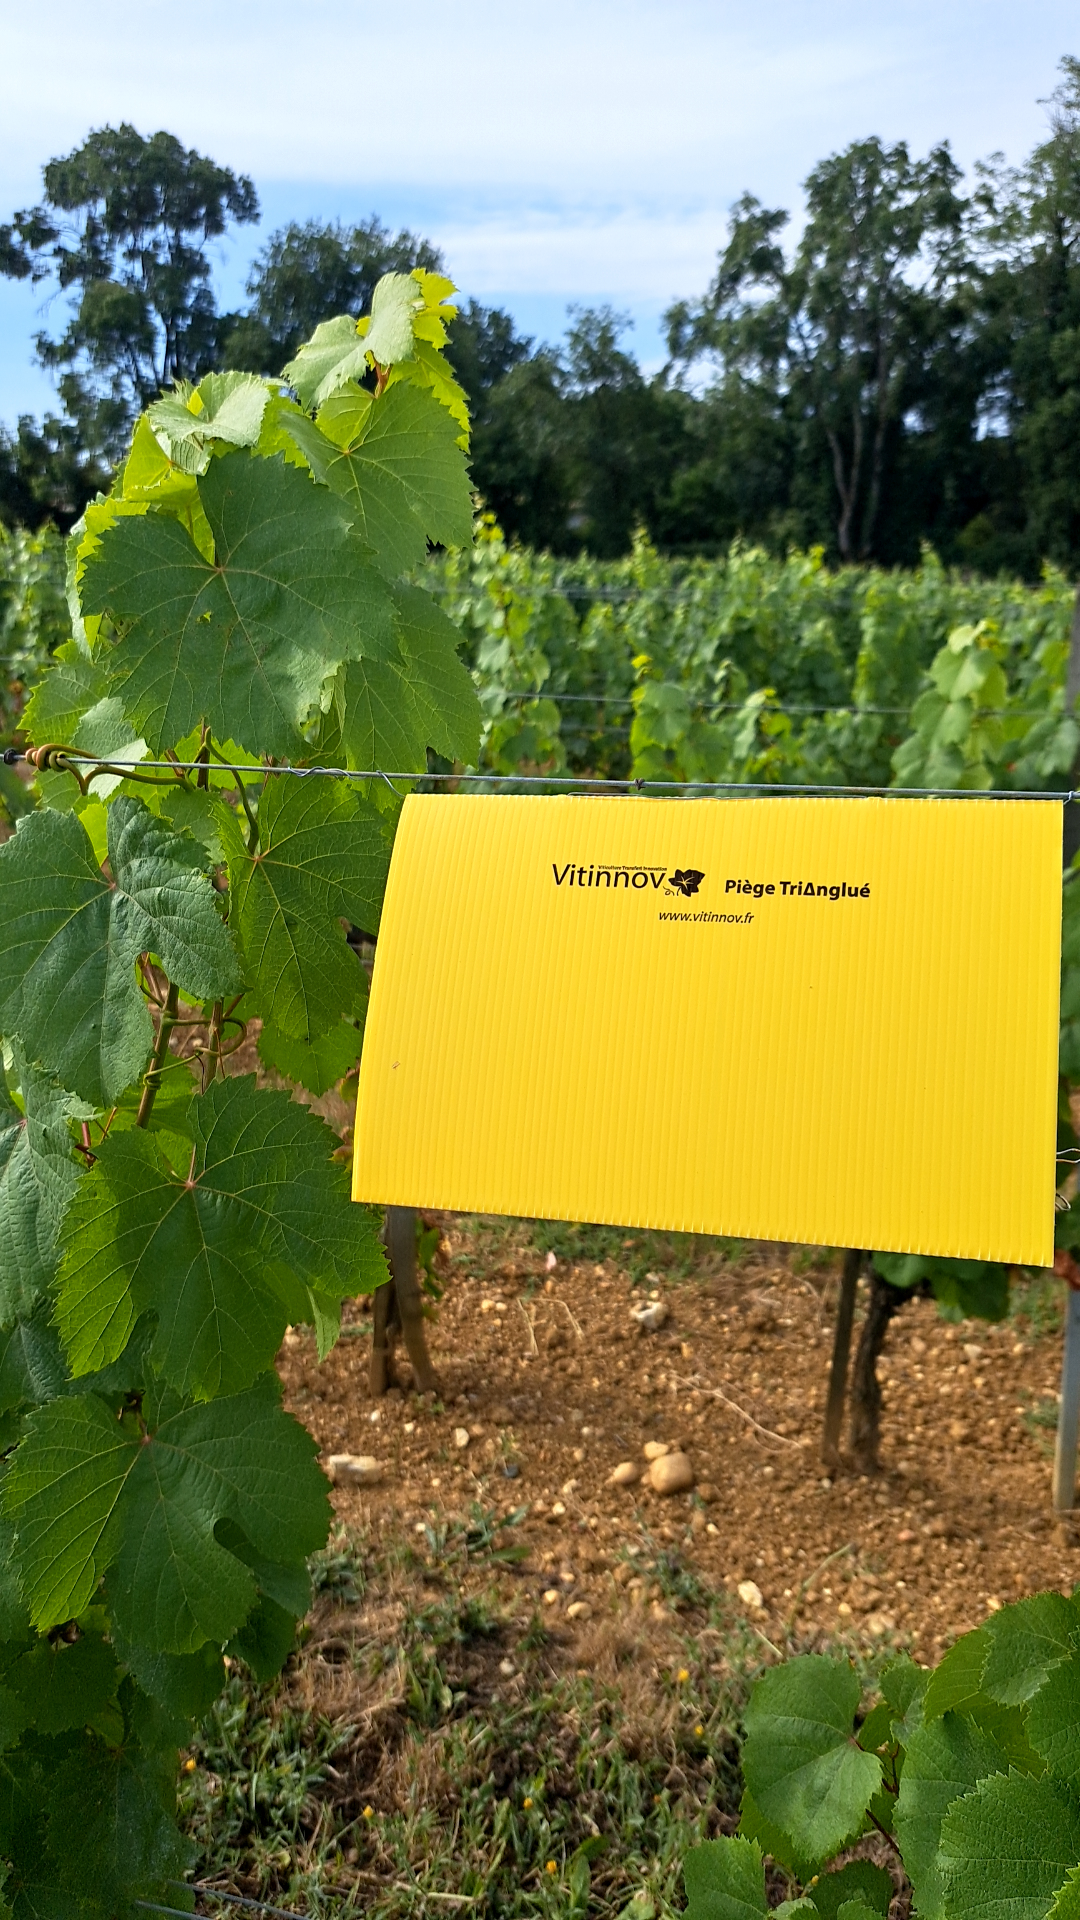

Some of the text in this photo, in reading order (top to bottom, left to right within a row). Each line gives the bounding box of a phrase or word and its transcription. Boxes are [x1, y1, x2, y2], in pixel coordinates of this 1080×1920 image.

[552, 863, 666, 889] Vitinnov
[725, 879, 775, 898] Piège
[658, 911, 754, 924] www.vitinnov.fr
